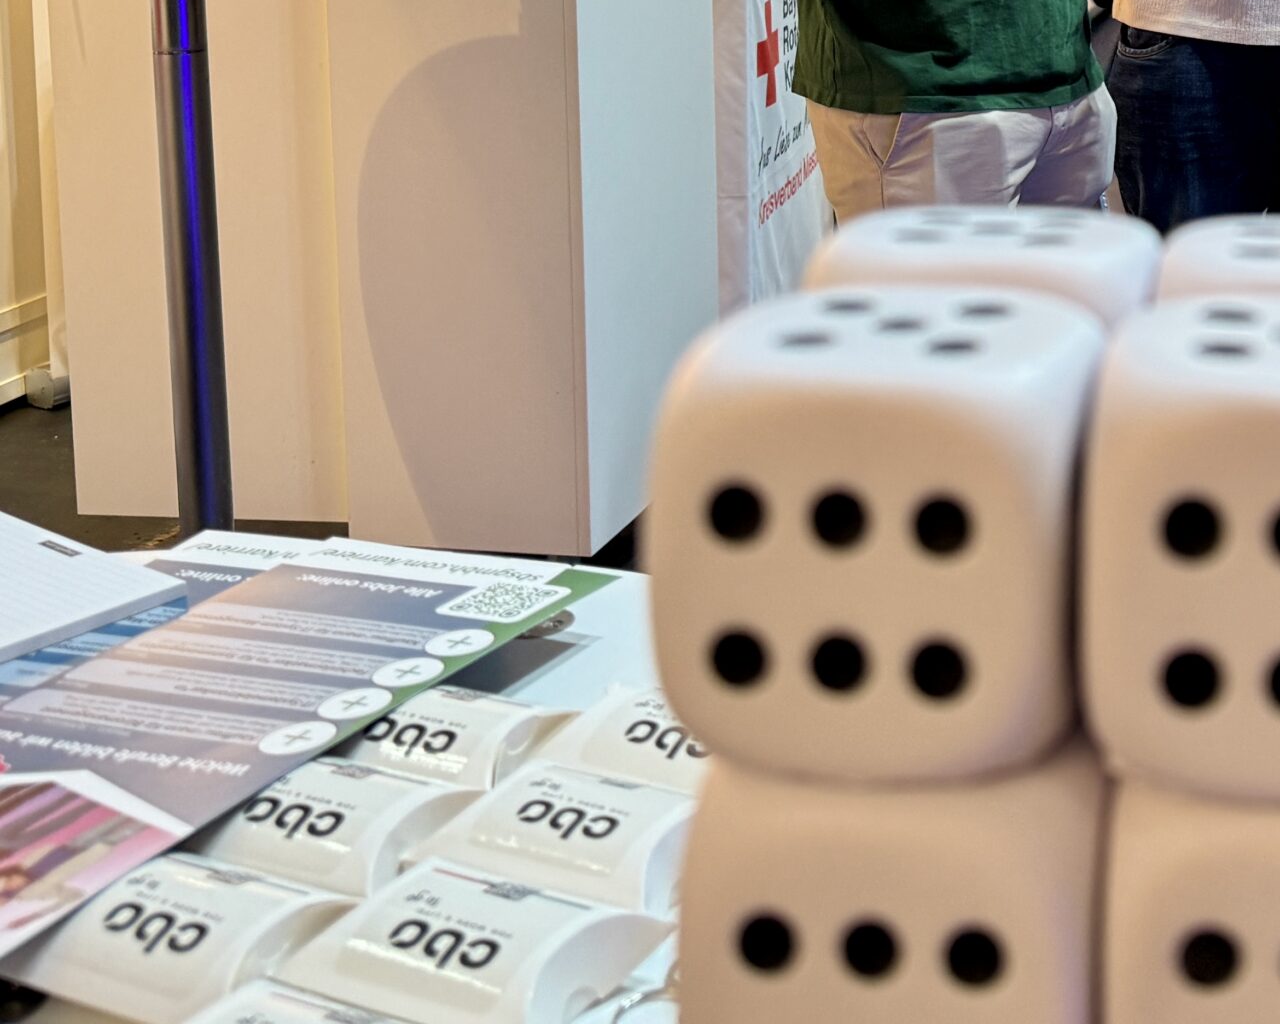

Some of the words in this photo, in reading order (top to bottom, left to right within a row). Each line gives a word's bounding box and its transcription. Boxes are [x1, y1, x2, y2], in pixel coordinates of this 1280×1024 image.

[297, 573, 360, 588] online:
[359, 580, 400, 593] Jobs
[401, 584, 443, 599] Alle
